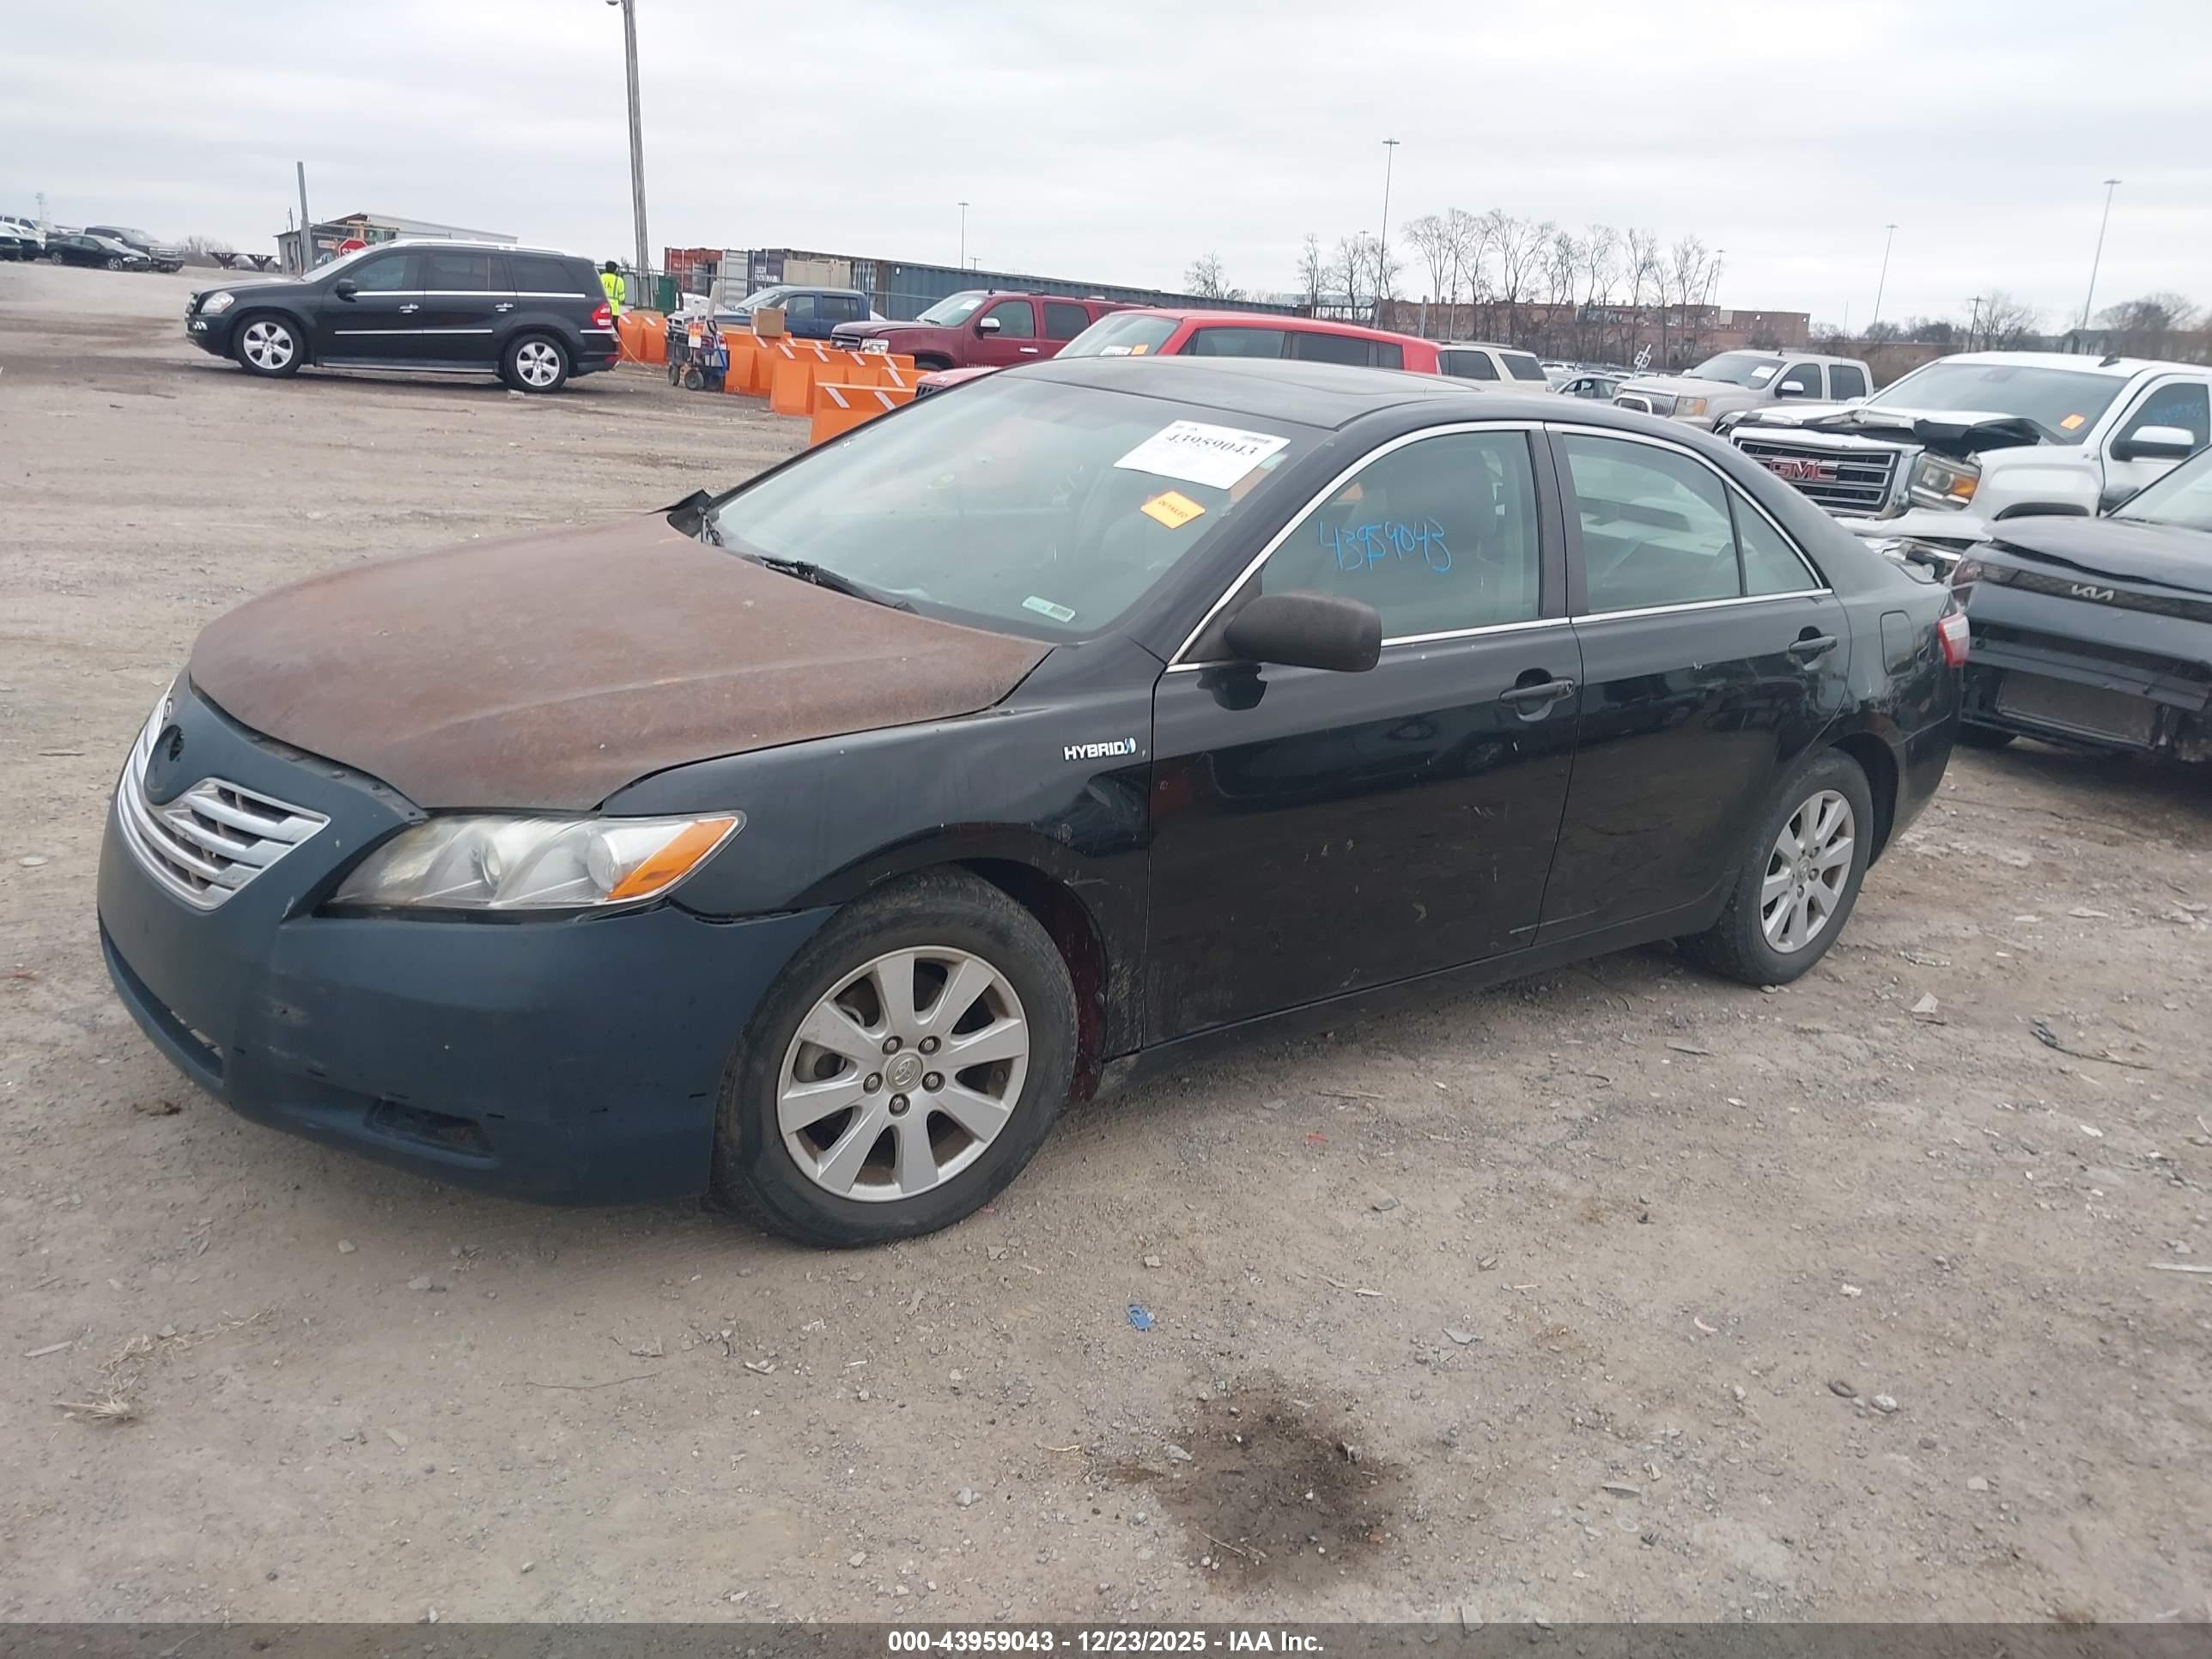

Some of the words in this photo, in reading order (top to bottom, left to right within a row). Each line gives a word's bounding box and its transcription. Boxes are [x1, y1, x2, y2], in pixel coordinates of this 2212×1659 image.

[1635, 353, 1650, 367] 20
[1770, 459, 1838, 481] GMC
[1318, 516, 1451, 572] 43959043
[2070, 584, 2116, 602] KIA
[1063, 741, 1127, 761] HYBRID
